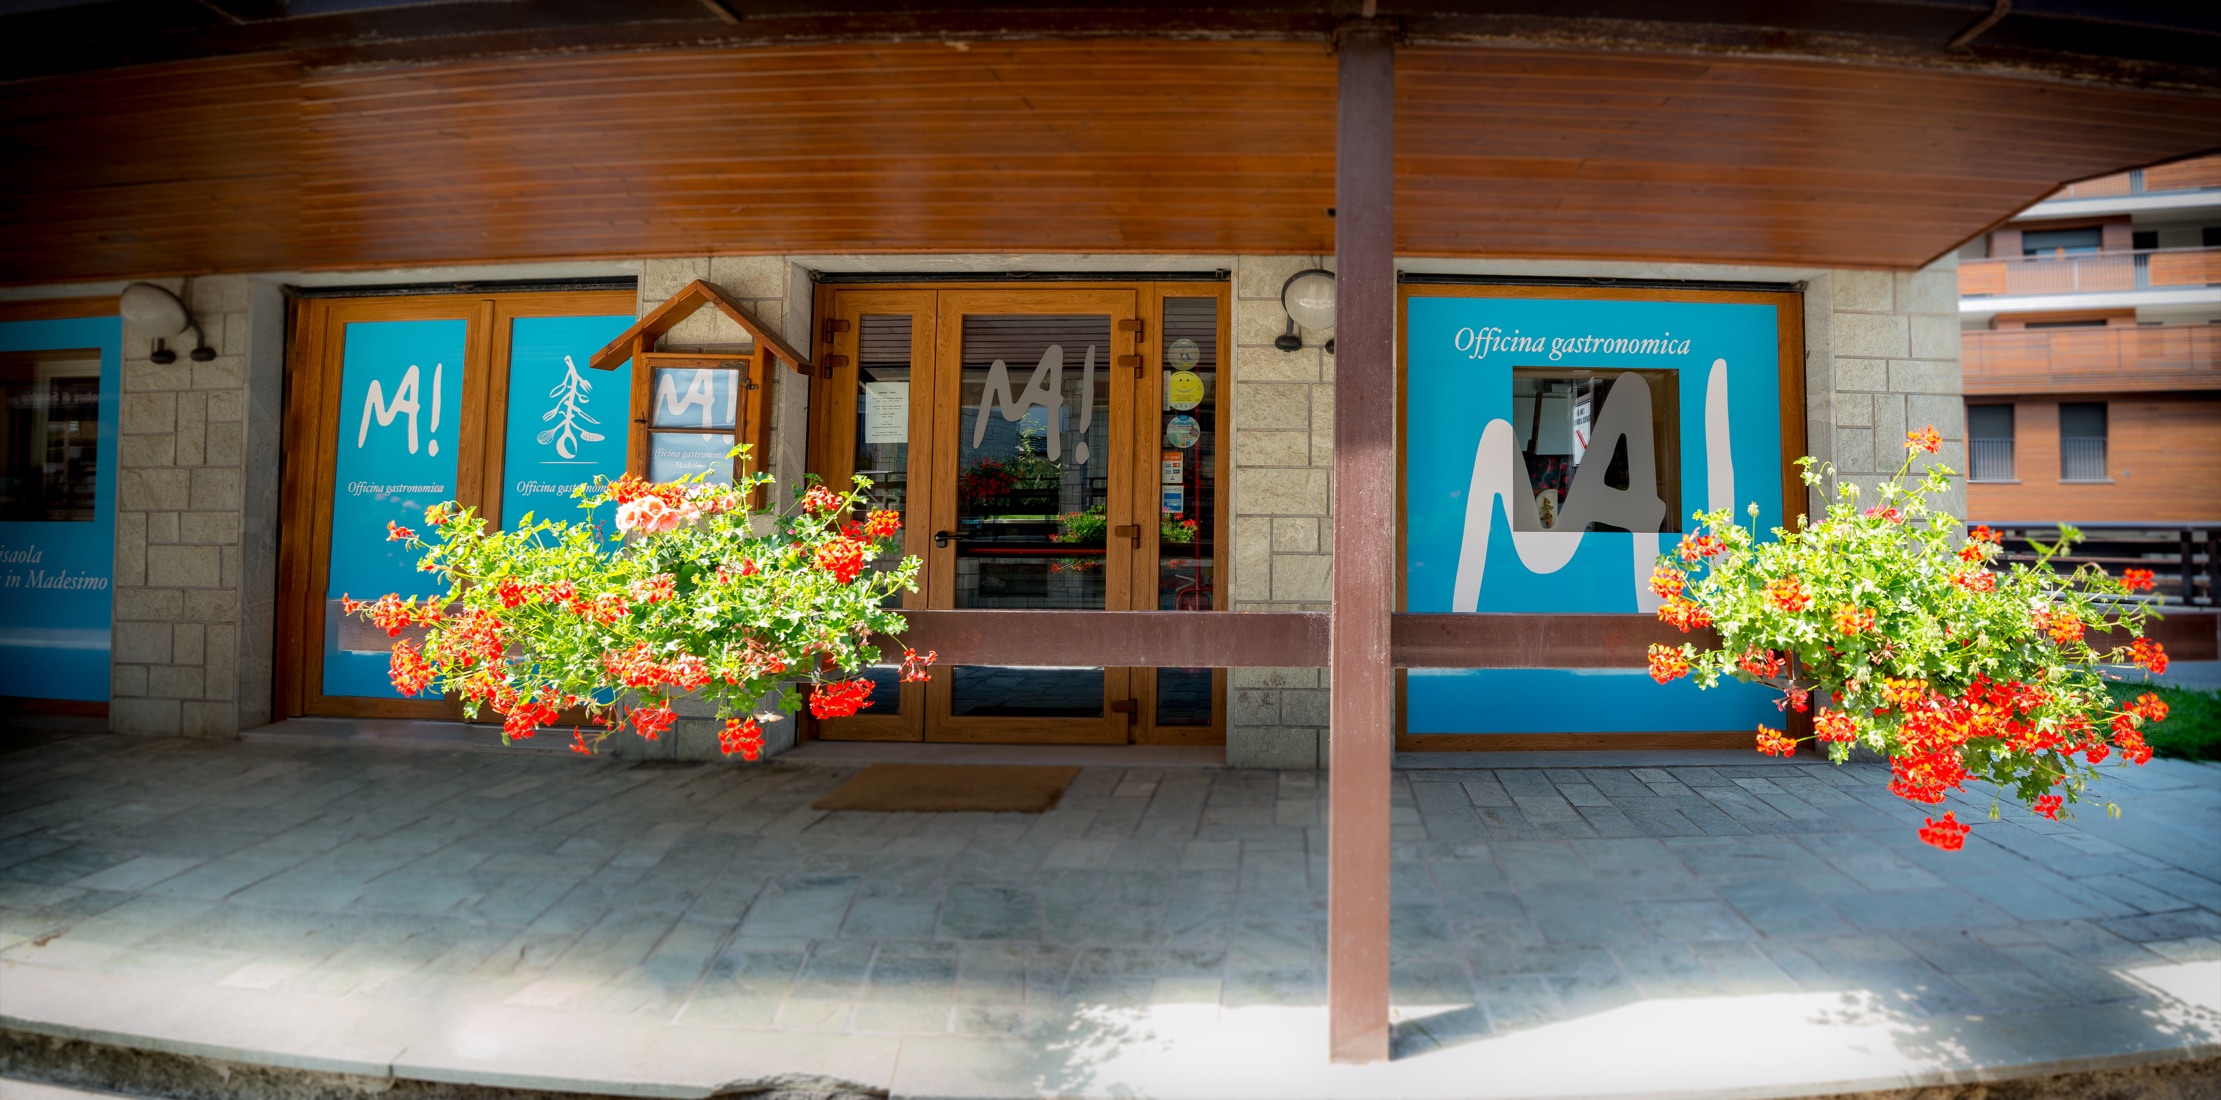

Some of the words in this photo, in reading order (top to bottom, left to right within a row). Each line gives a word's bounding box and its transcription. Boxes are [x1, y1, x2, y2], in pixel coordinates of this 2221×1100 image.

[1455, 327, 1546, 359] Officina
[1549, 332, 1691, 361] gastronomica
[651, 447, 681, 459] fficina
[674, 461, 706, 469] Madesimo
[348, 481, 384, 496] Officina
[385, 482, 444, 496] gastronomica
[516, 481, 555, 496] Officina
[5, 569, 21, 588] in
[24, 569, 108, 590] Madesimo
